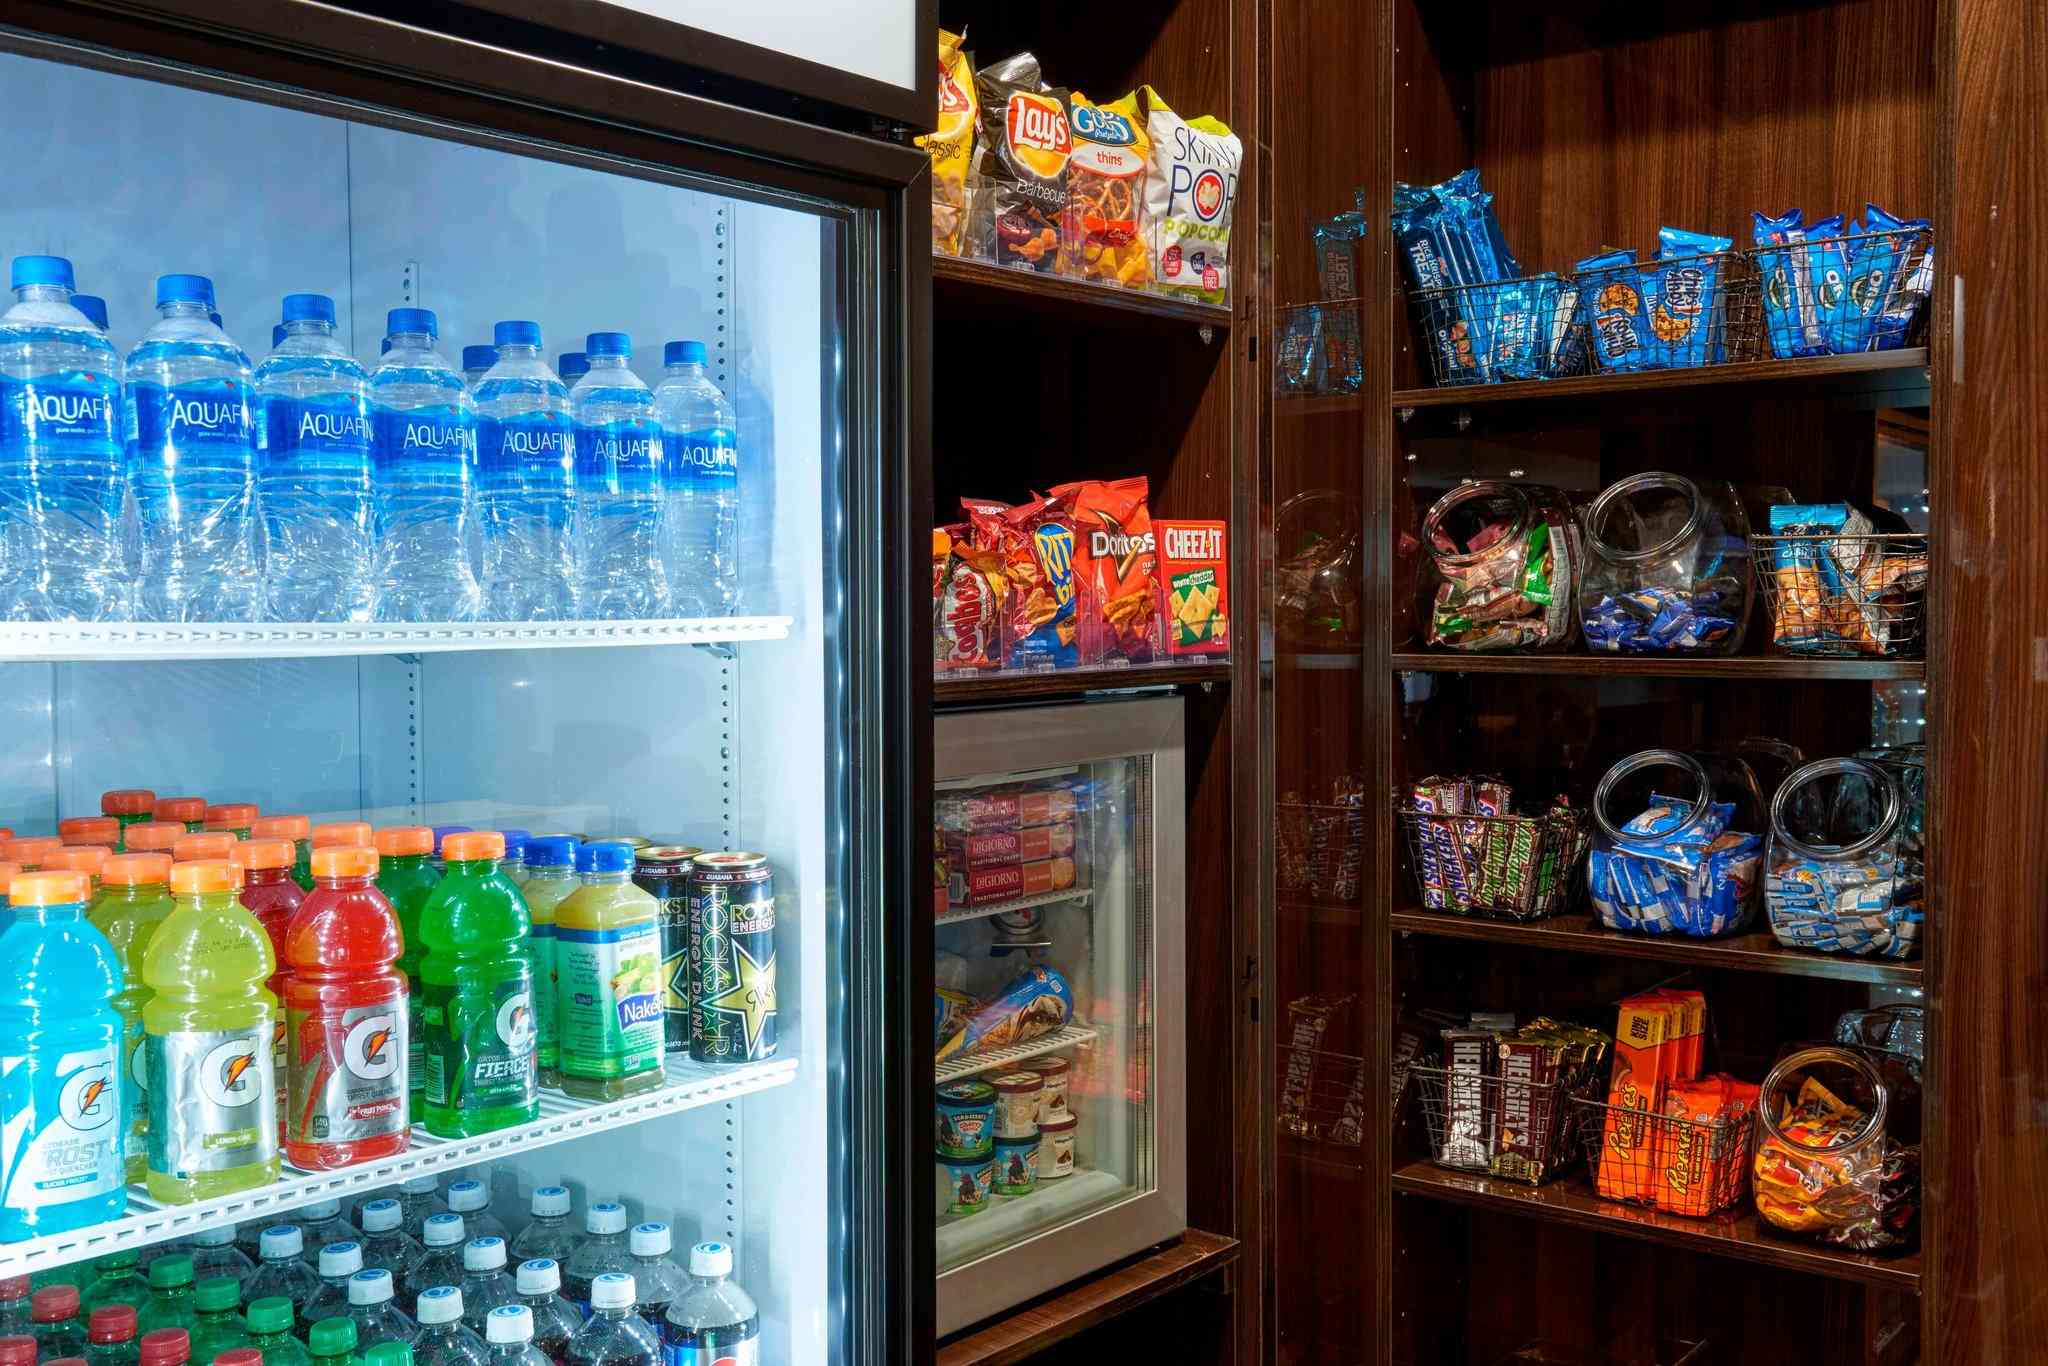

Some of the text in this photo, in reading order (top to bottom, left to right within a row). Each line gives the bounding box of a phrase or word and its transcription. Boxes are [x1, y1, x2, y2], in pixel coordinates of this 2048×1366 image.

[1013, 96, 1067, 151] Lay's
[926, 136, 960, 160] lassic
[1096, 150, 1123, 167] thins
[1172, 126, 1238, 170] SKINNY
[1016, 177, 1067, 203] Barbecue
[1166, 163, 1239, 226] POP
[1091, 530, 1156, 557] Doritos
[1165, 527, 1223, 559] CHEEZ-IT
[689, 897, 701, 974] ENERGY
[1630, 1015, 1642, 1039] KING
[1639, 1015, 1650, 1041] SIZE
[474, 1055, 528, 1079] FIERCE
